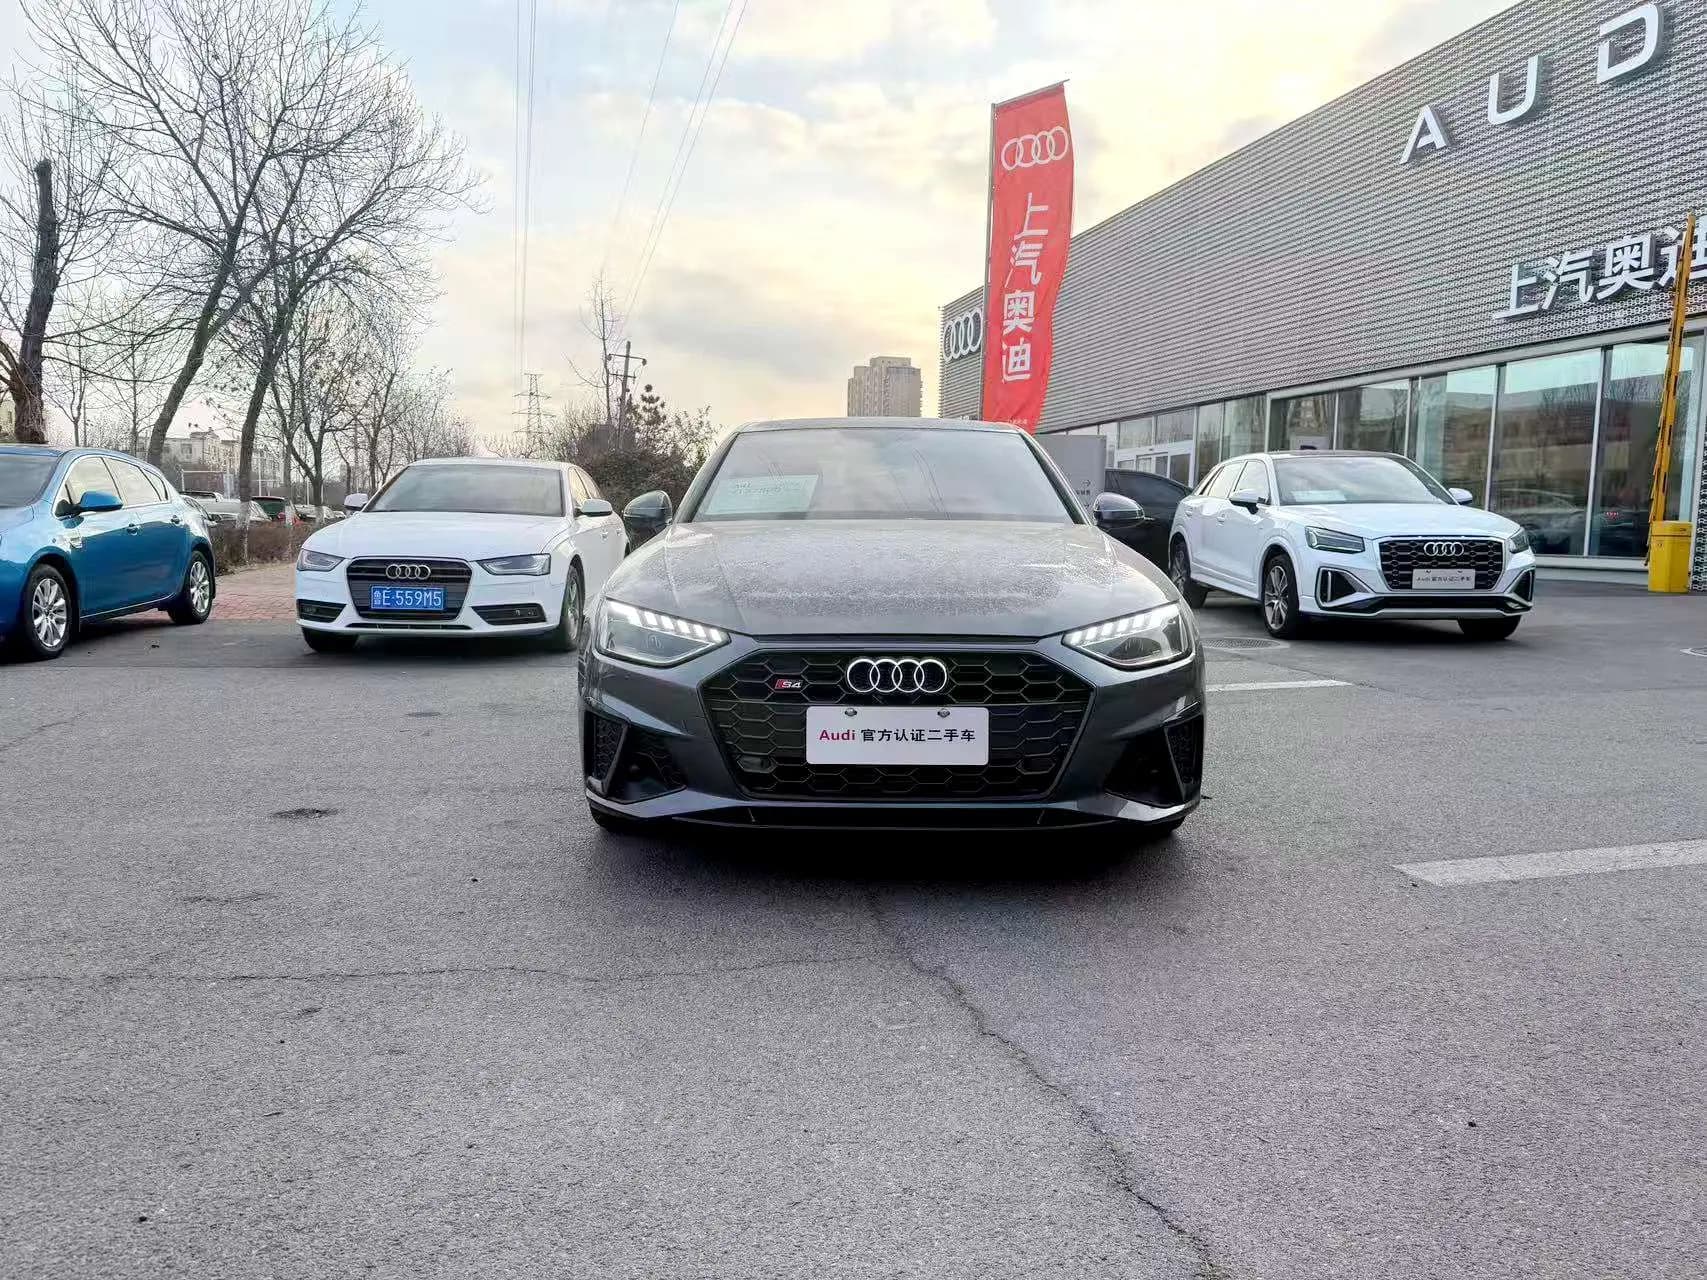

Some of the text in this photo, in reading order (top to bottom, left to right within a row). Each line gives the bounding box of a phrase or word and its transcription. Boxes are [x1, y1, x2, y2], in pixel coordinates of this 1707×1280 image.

[1399, 2, 1665, 165] AUD
[1002, 192, 1049, 384] 上汽奥迪
[819, 728, 977, 742] Audi 官方认证二手车
